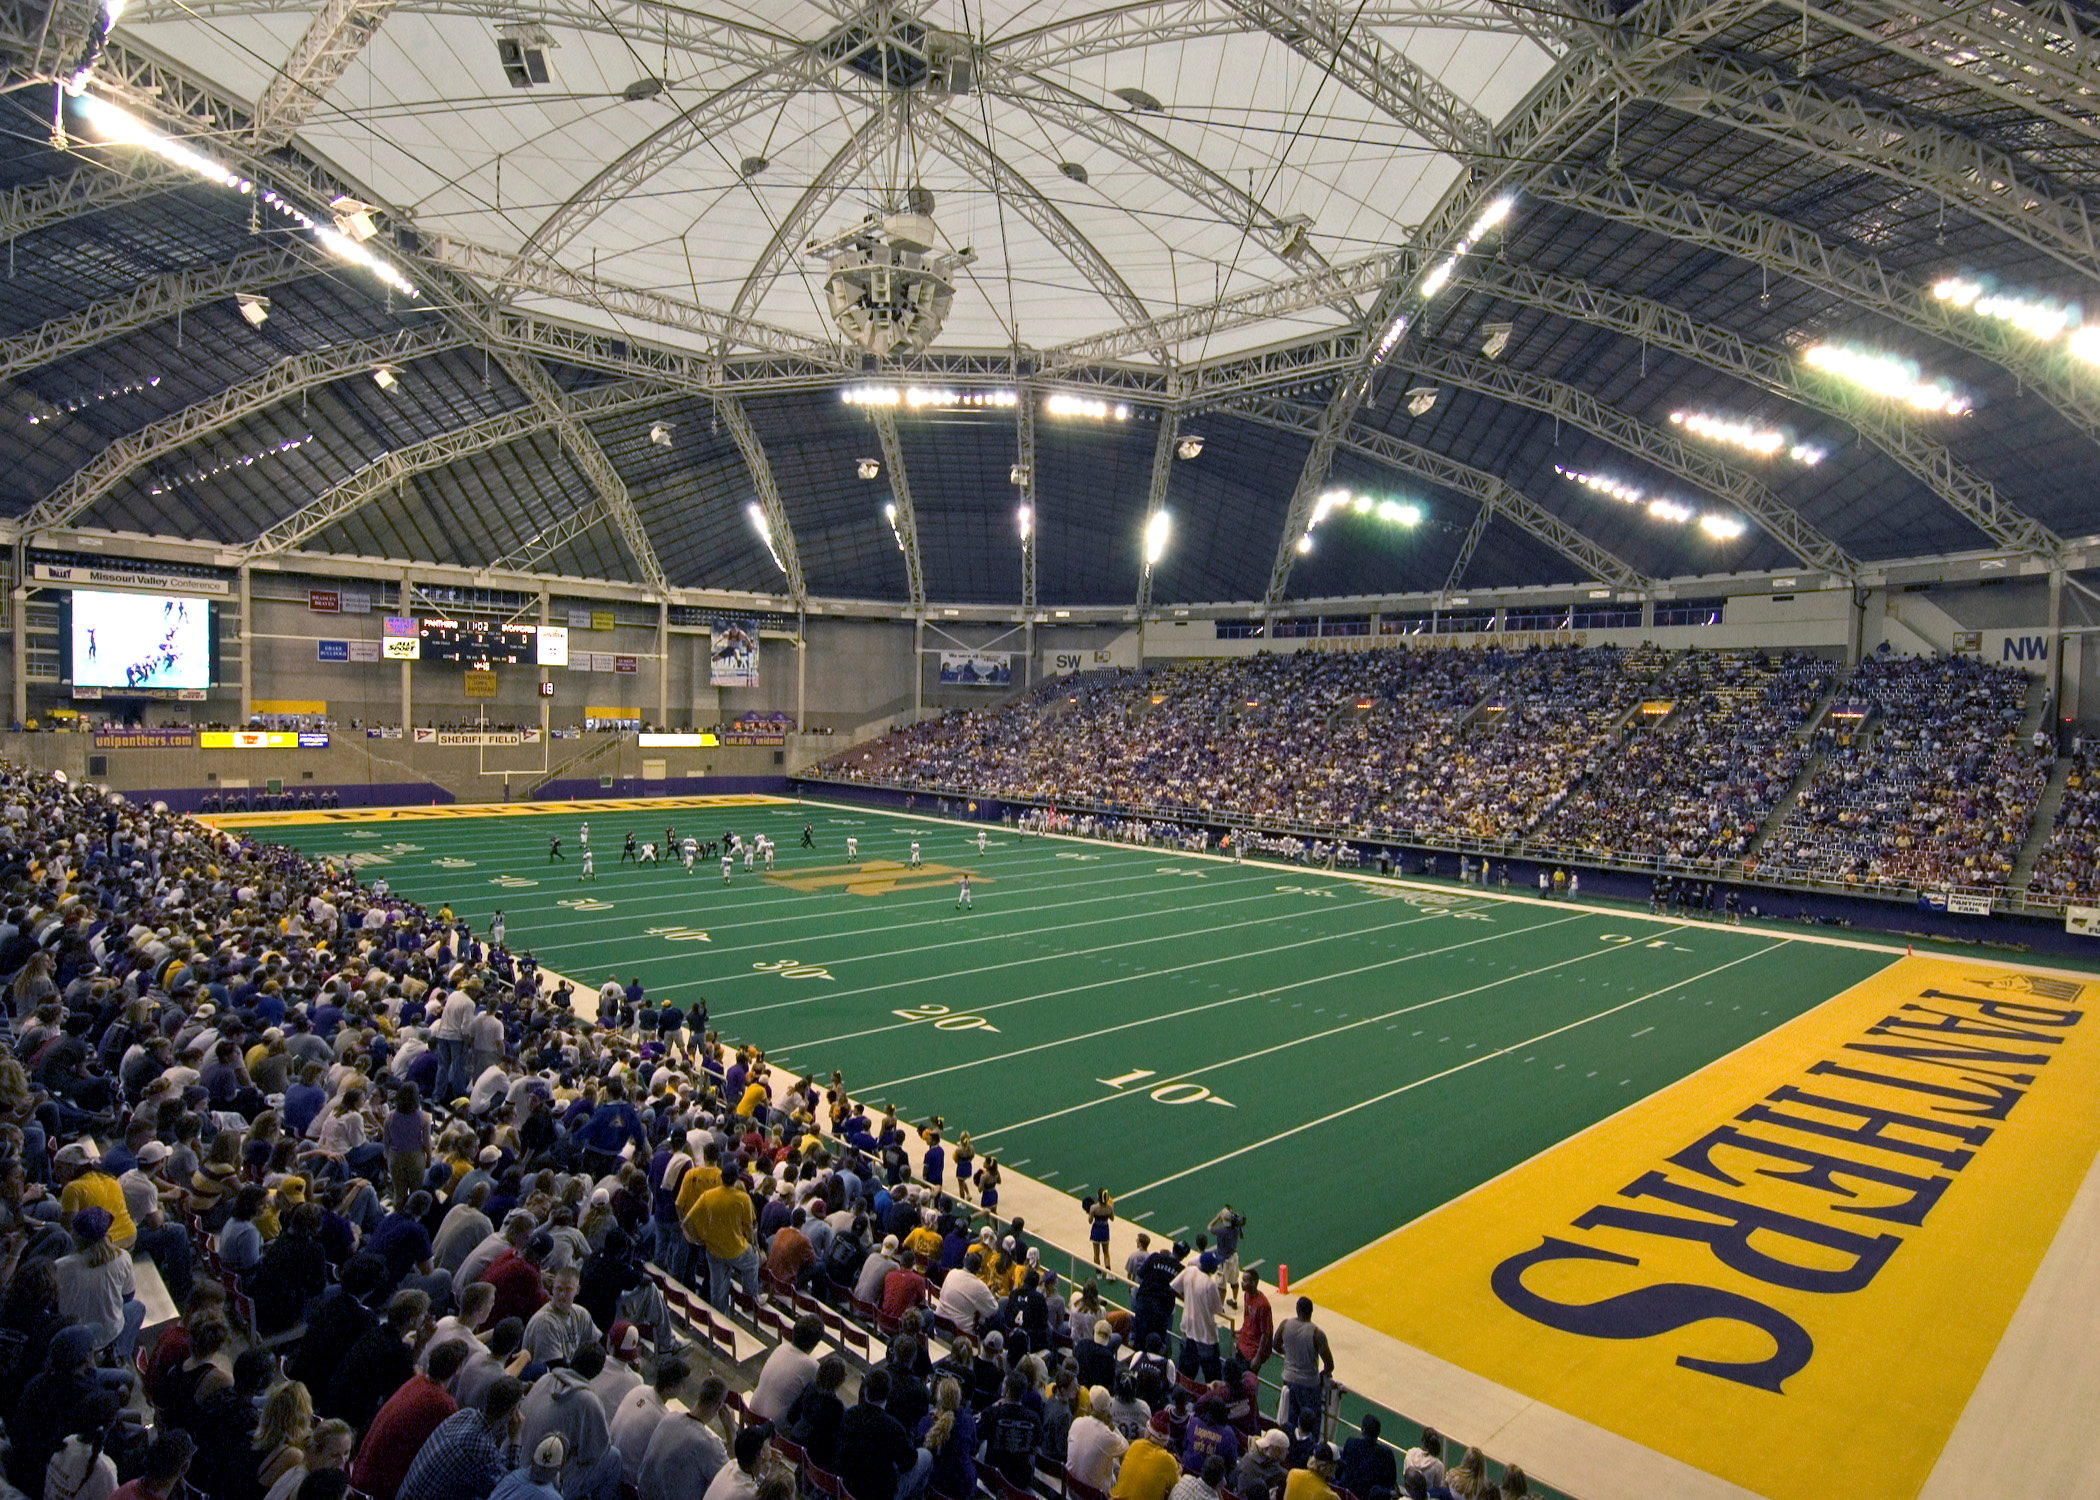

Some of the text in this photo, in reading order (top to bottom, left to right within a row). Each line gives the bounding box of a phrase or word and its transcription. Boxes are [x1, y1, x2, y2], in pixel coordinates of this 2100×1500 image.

[90, 571, 221, 591] Missouri Valley Conference
[1305, 631, 1588, 650] NORTHERN IOWA PANTHERS
[2003, 636, 2049, 661] NW
[1056, 654, 1082, 669] SW
[542, 682, 554, 695] 18
[95, 734, 192, 748] unipanthers.com
[440, 735, 484, 744] SHERIFF
[488, 736, 518, 744] FIELD
[726, 736, 784, 745] uni.edu/unidome
[1950, 900, 1989, 908] PANTHER
[644, 926, 708, 941] 40
[753, 960, 828, 980] 30
[892, 1003, 987, 1032] 20
[1096, 1068, 1212, 1105] 10
[1490, 989, 2084, 1395] PANTHERS
[1014, 1310, 1024, 1326] 4
